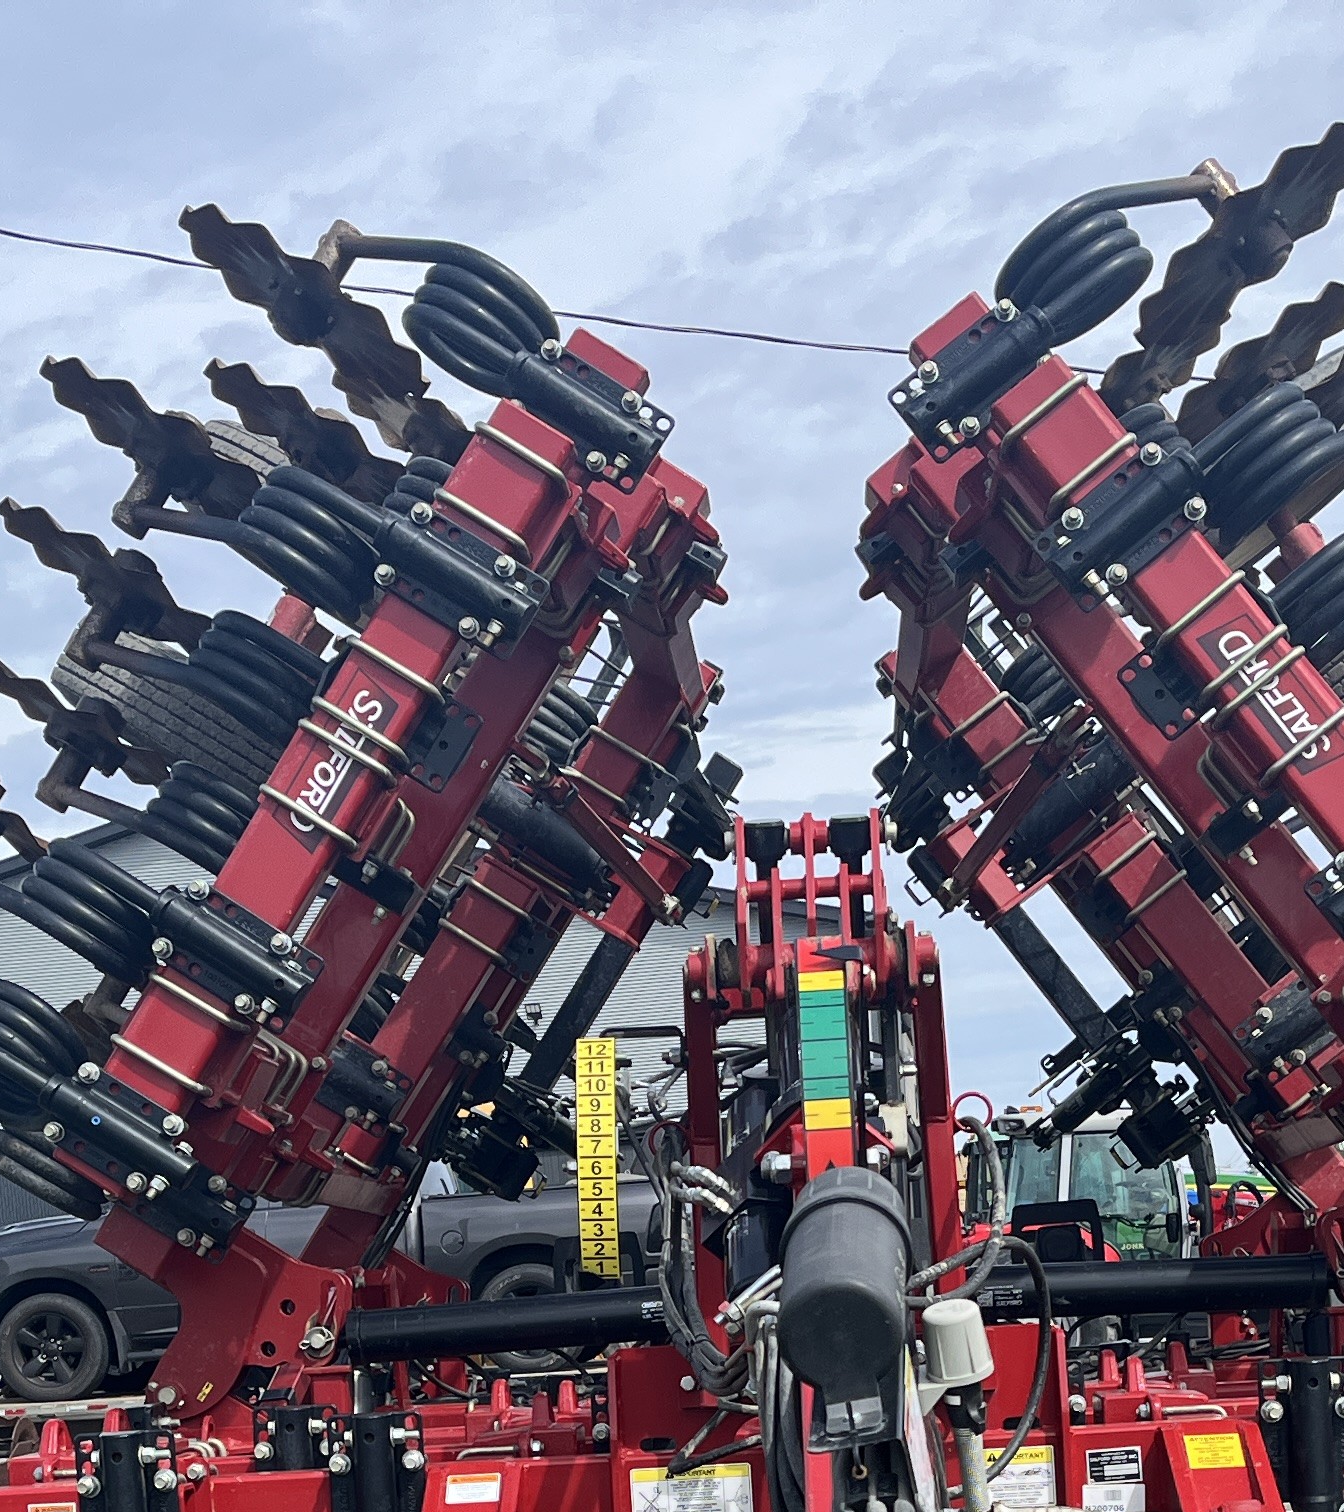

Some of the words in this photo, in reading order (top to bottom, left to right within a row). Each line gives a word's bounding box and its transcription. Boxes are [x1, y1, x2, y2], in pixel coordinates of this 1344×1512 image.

[585, 1044, 607, 1056] 12
[585, 1061, 605, 1074] 11
[585, 1078, 606, 1092] 10
[590, 1098, 601, 1112] 9
[590, 1118, 602, 1133] 8
[590, 1139, 602, 1154] 7
[591, 1161, 602, 1175] 6
[592, 1182, 603, 1197] 5
[591, 1202, 604, 1217] 4
[593, 1223, 604, 1237] 3
[594, 1242, 605, 1256] 2
[595, 1261, 604, 1274] 1
